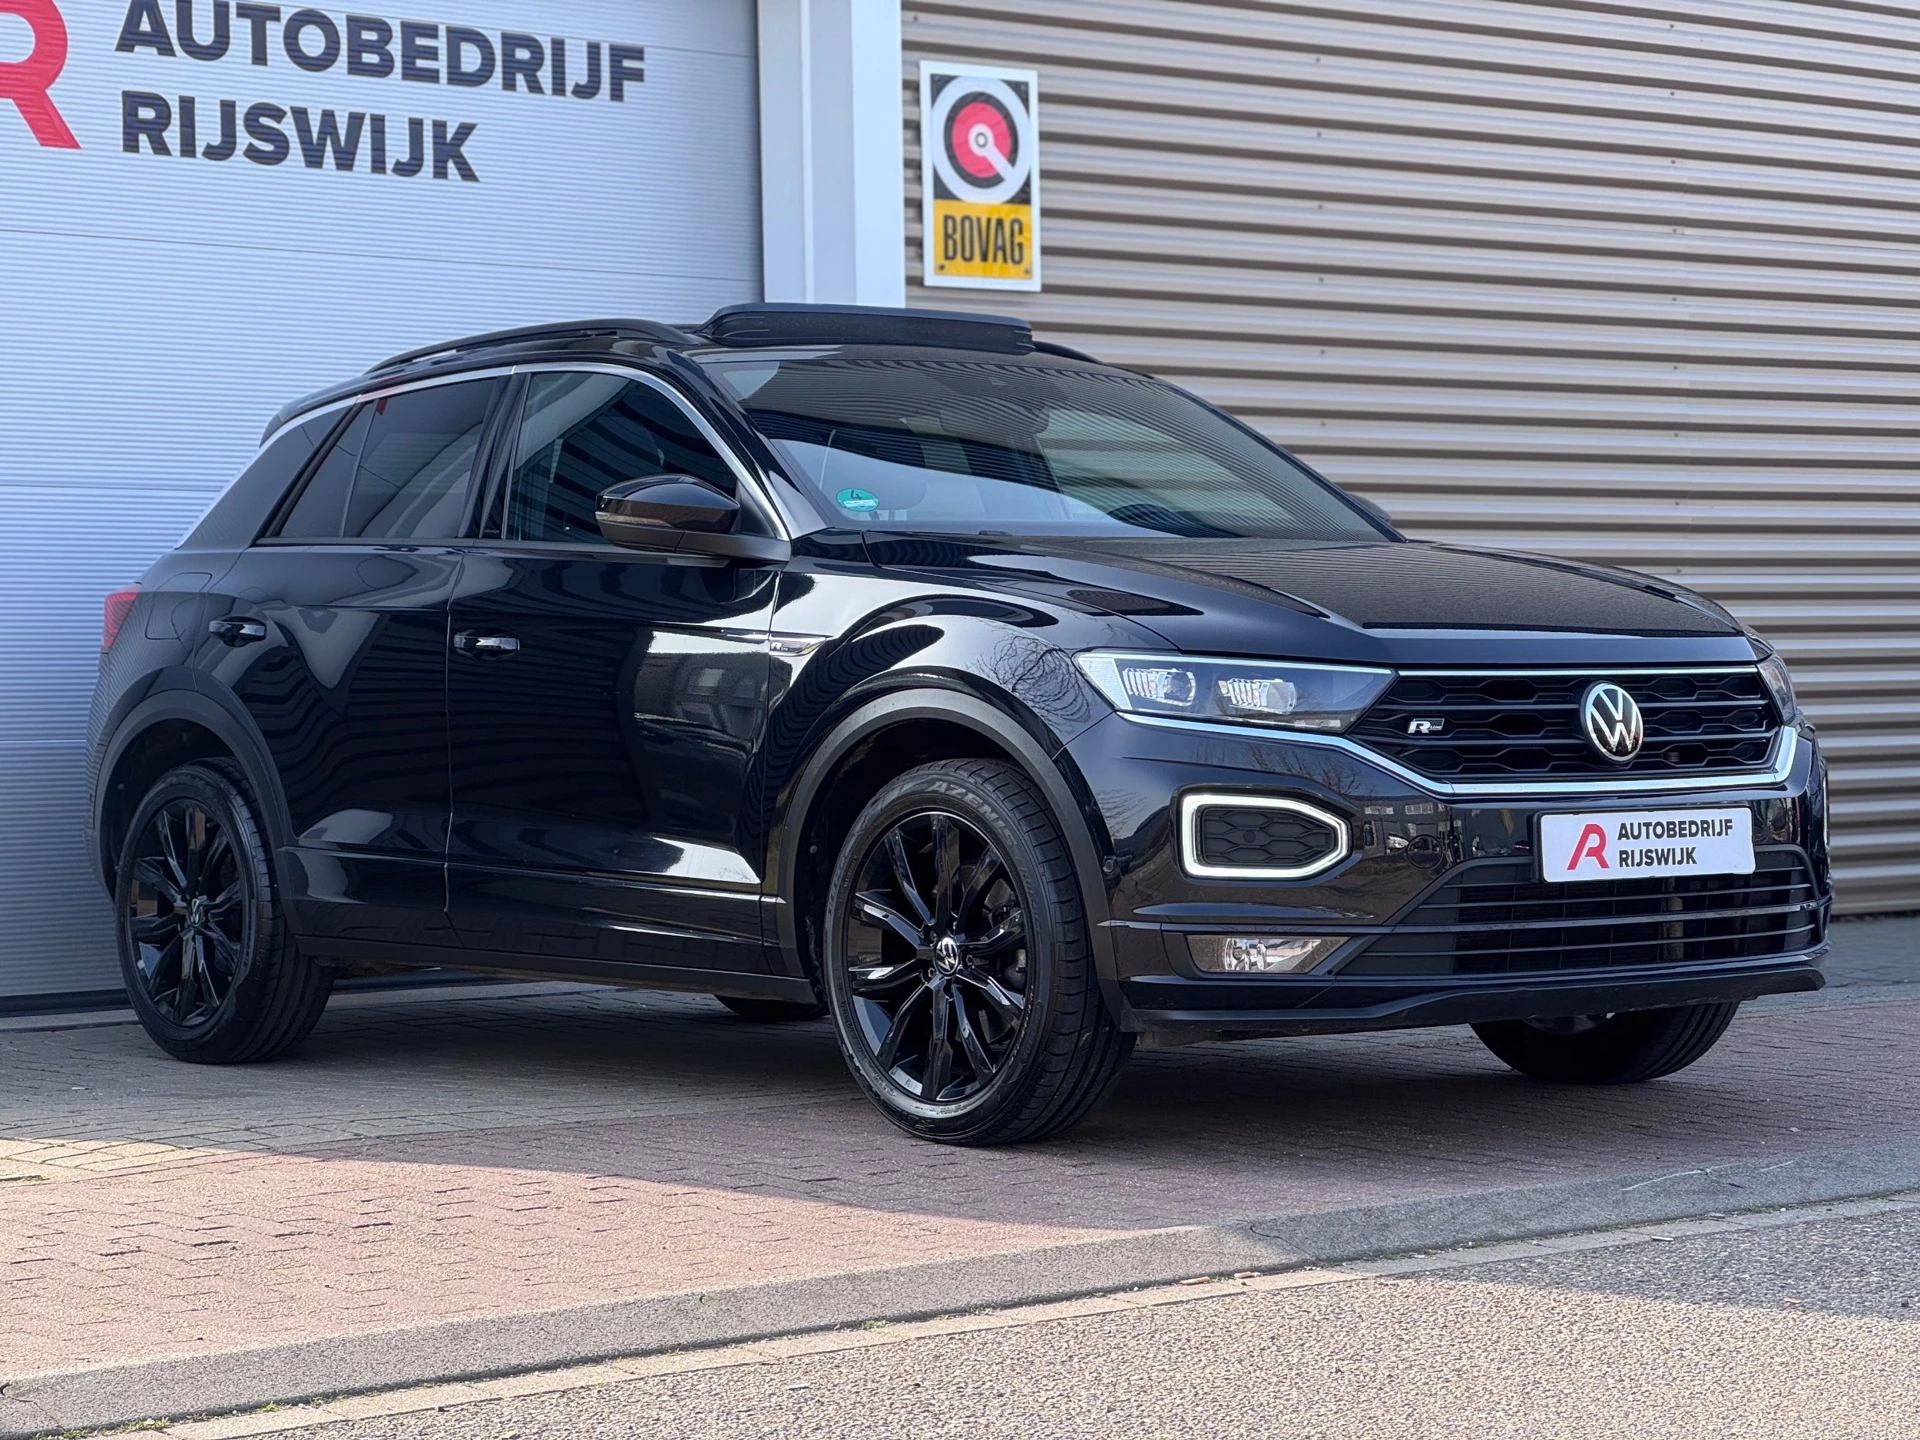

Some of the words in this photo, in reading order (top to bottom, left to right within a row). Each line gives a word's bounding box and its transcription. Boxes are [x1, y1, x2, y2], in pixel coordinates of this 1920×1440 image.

[115, 0, 645, 102] AUTOBEDRIJF
[121, 90, 480, 183] RIJSWIJK
[943, 214, 1024, 265] BOVAG
[924, 781, 1018, 846] AZENIS
[1617, 818, 1733, 841] AUTOBEDRIJF
[1618, 846, 1698, 868] RIJSWIJK
